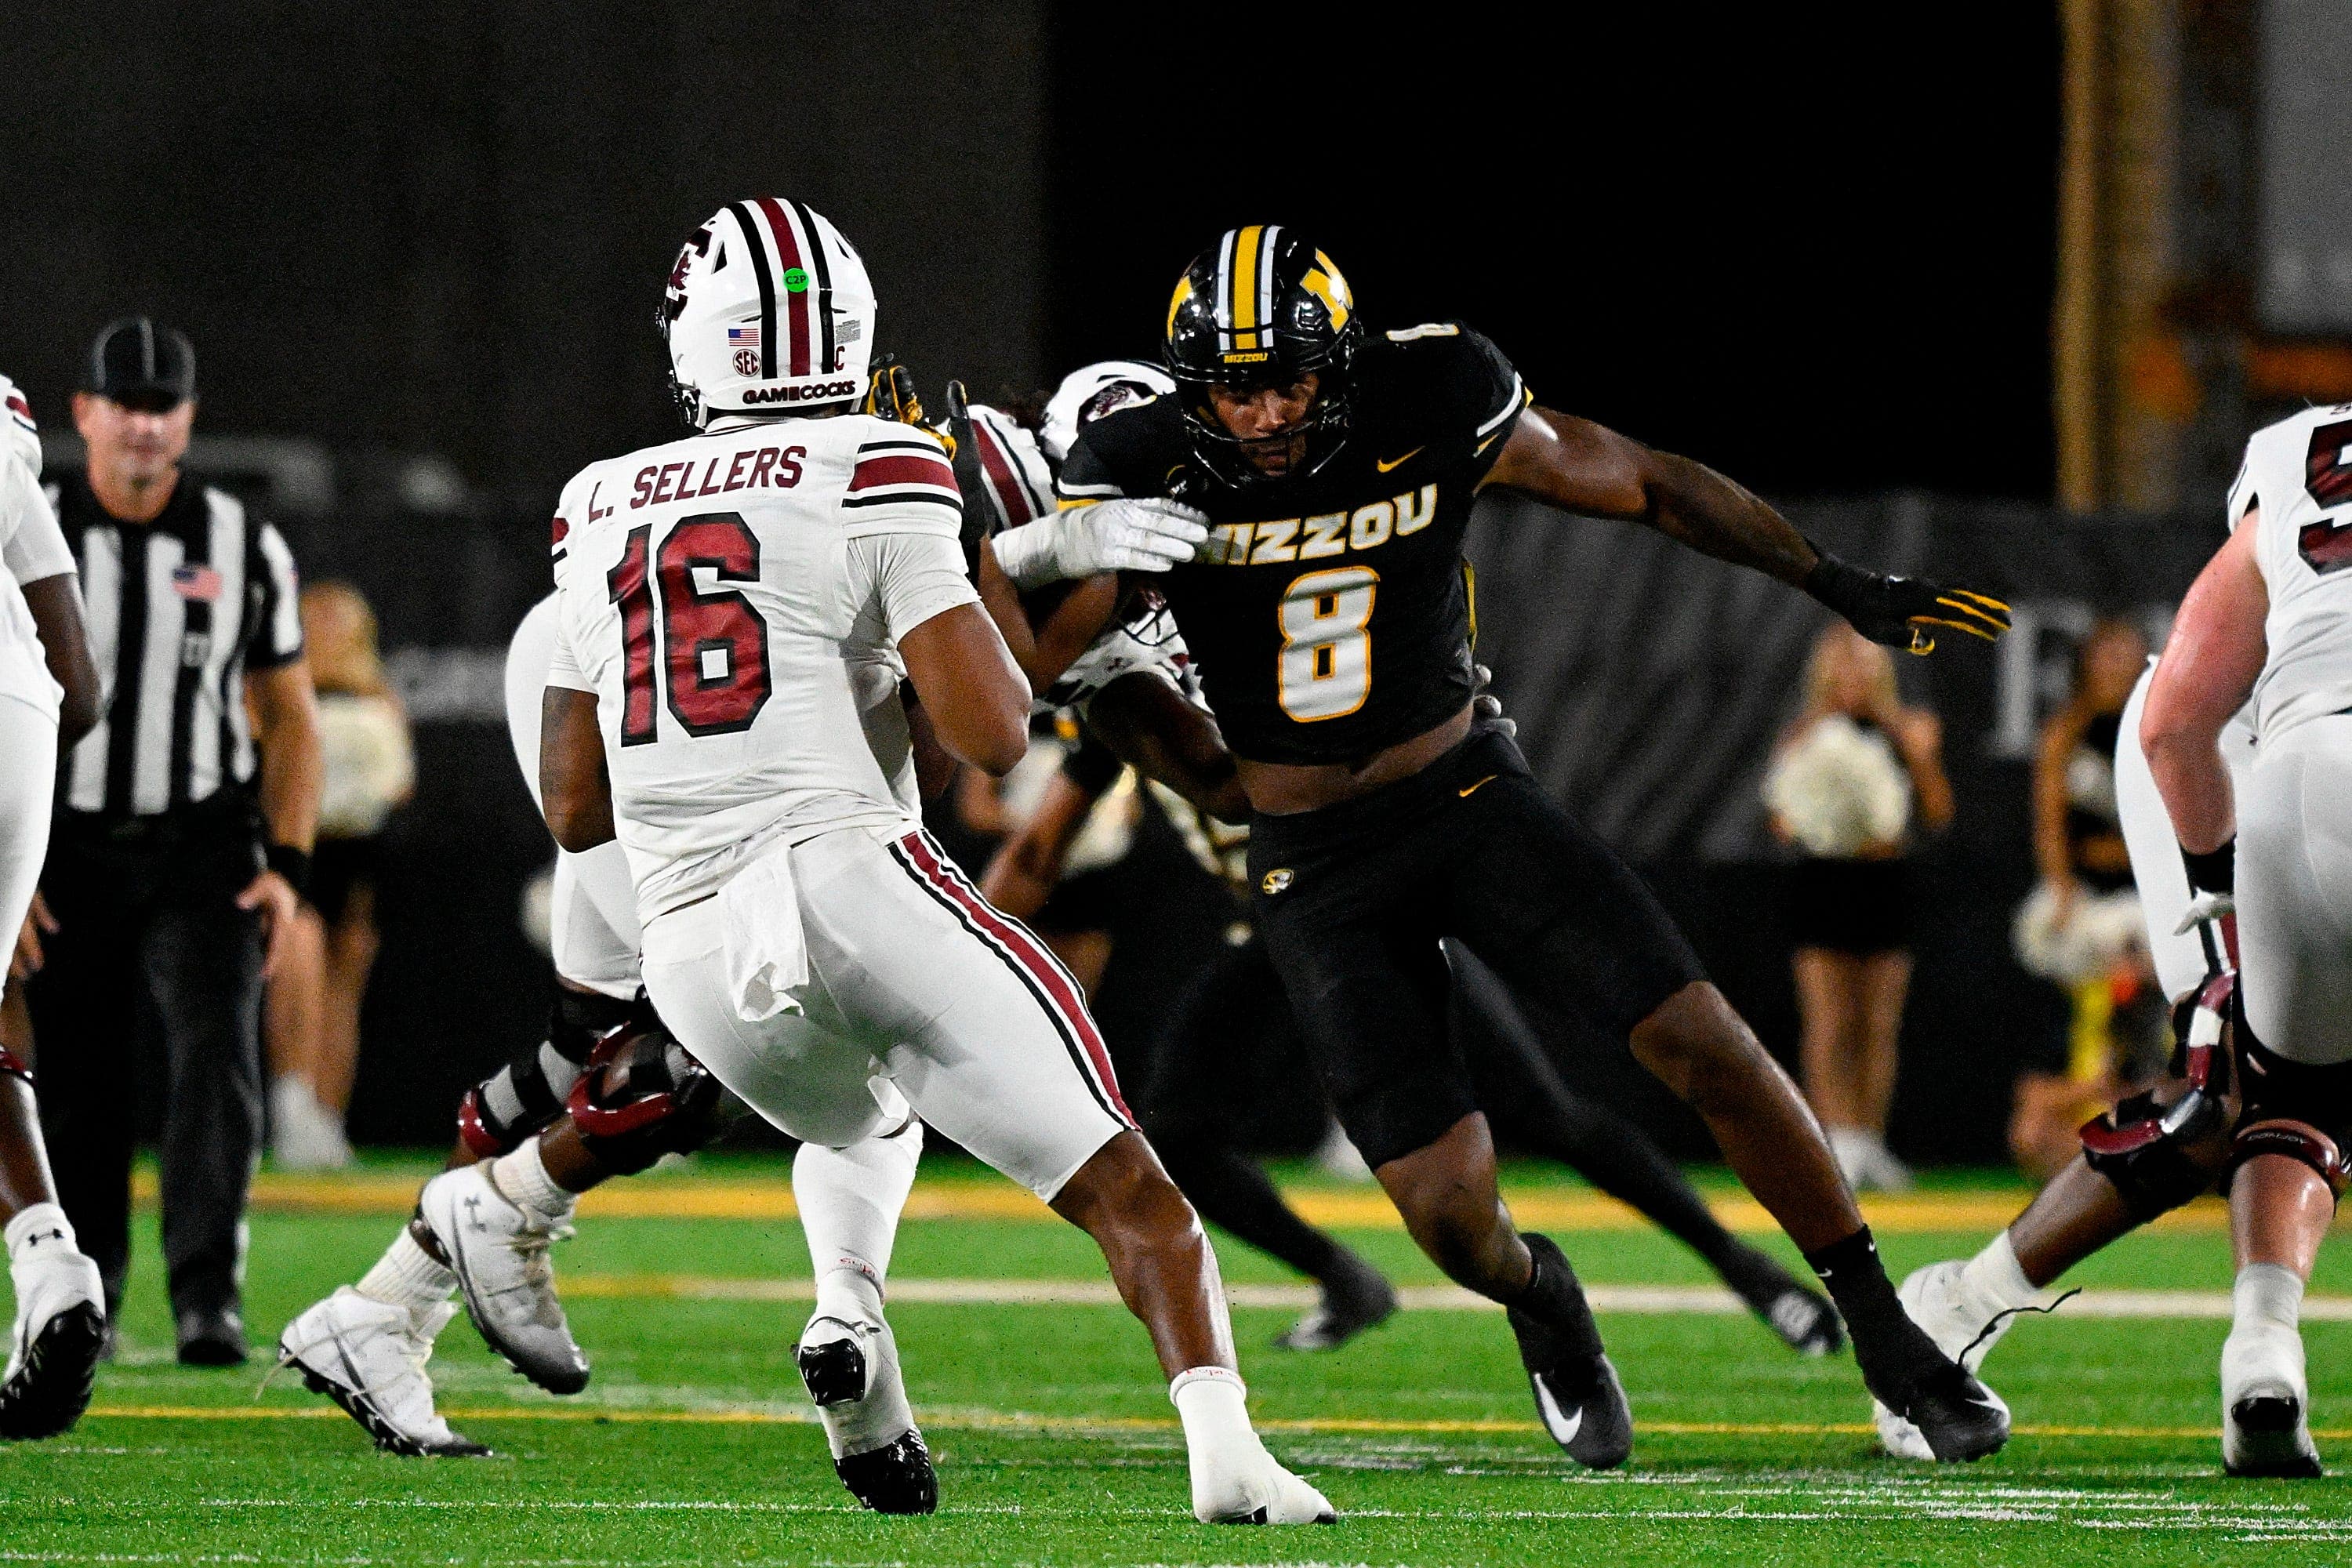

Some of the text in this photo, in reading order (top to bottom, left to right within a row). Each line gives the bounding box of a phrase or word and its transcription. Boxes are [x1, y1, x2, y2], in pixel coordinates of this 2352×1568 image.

[786, 275, 807, 285] C2P
[735, 350, 760, 375] SEC
[1224, 352, 1268, 363] MIZZOU
[742, 380, 856, 405] GAMECOCKS
[588, 445, 807, 524] L. SELLERS
[607, 511, 772, 748] 16
[1278, 565, 1381, 723] 8
